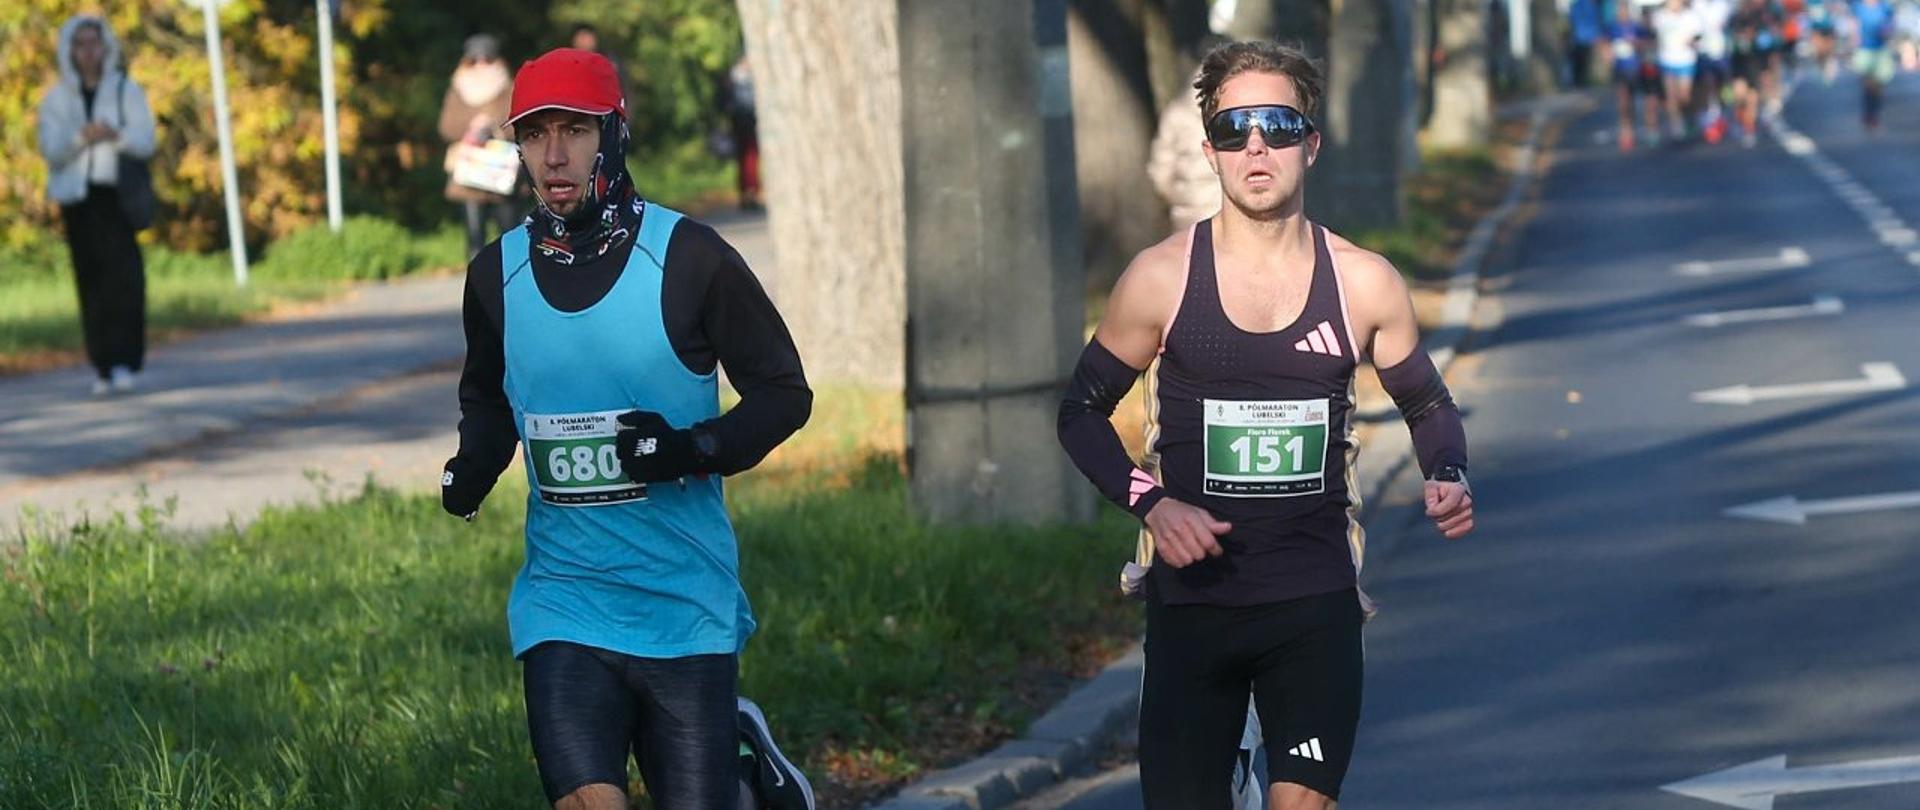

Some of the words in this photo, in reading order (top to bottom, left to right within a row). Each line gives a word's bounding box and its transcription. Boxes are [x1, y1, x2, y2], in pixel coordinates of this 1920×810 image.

[1252, 411, 1286, 419] LUBELSKI
[562, 423, 595, 432] LUBELSKI
[548, 443, 622, 482] 680
[1229, 435, 1304, 473] 151
